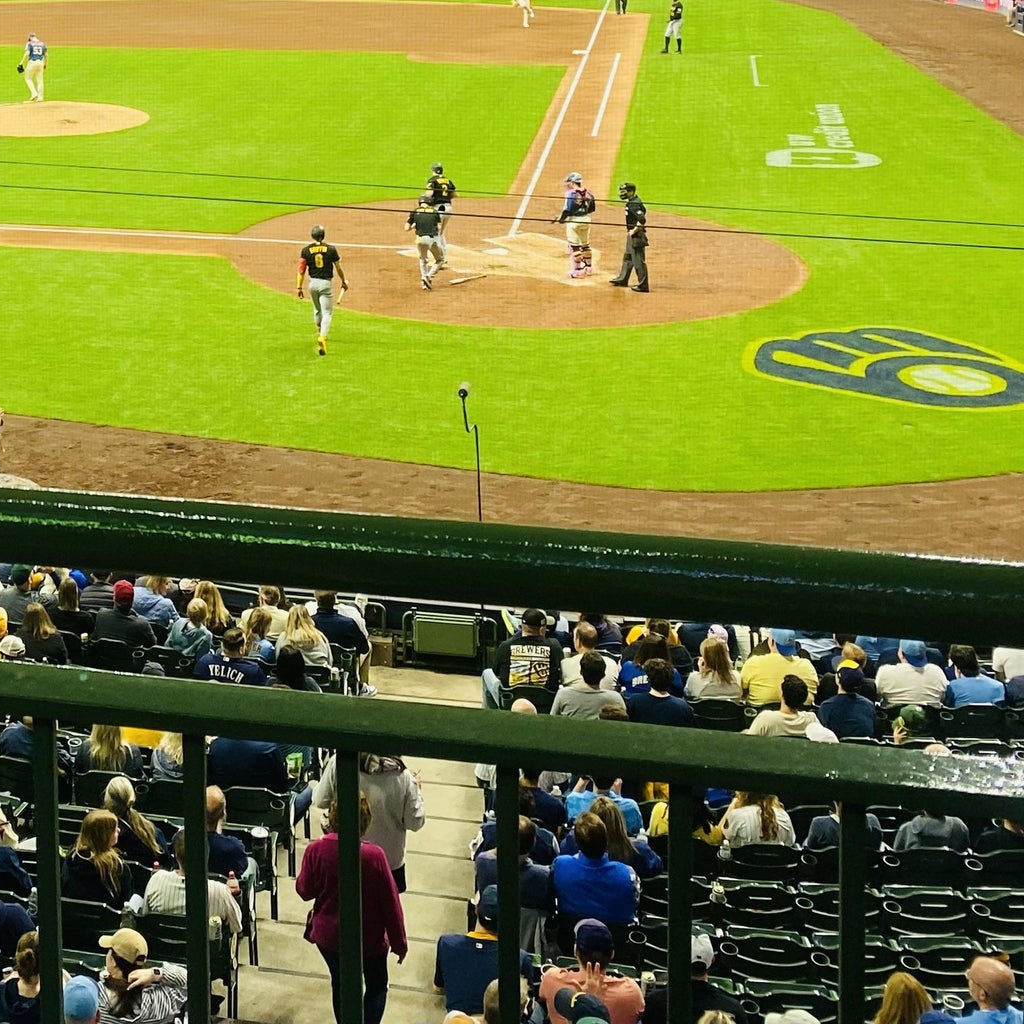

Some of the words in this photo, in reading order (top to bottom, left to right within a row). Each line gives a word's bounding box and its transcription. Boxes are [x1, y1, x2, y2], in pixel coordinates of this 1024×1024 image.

[32, 46, 43, 55] 53
[510, 644, 551, 657] BREWERS
[208, 663, 244, 684] YELICH
